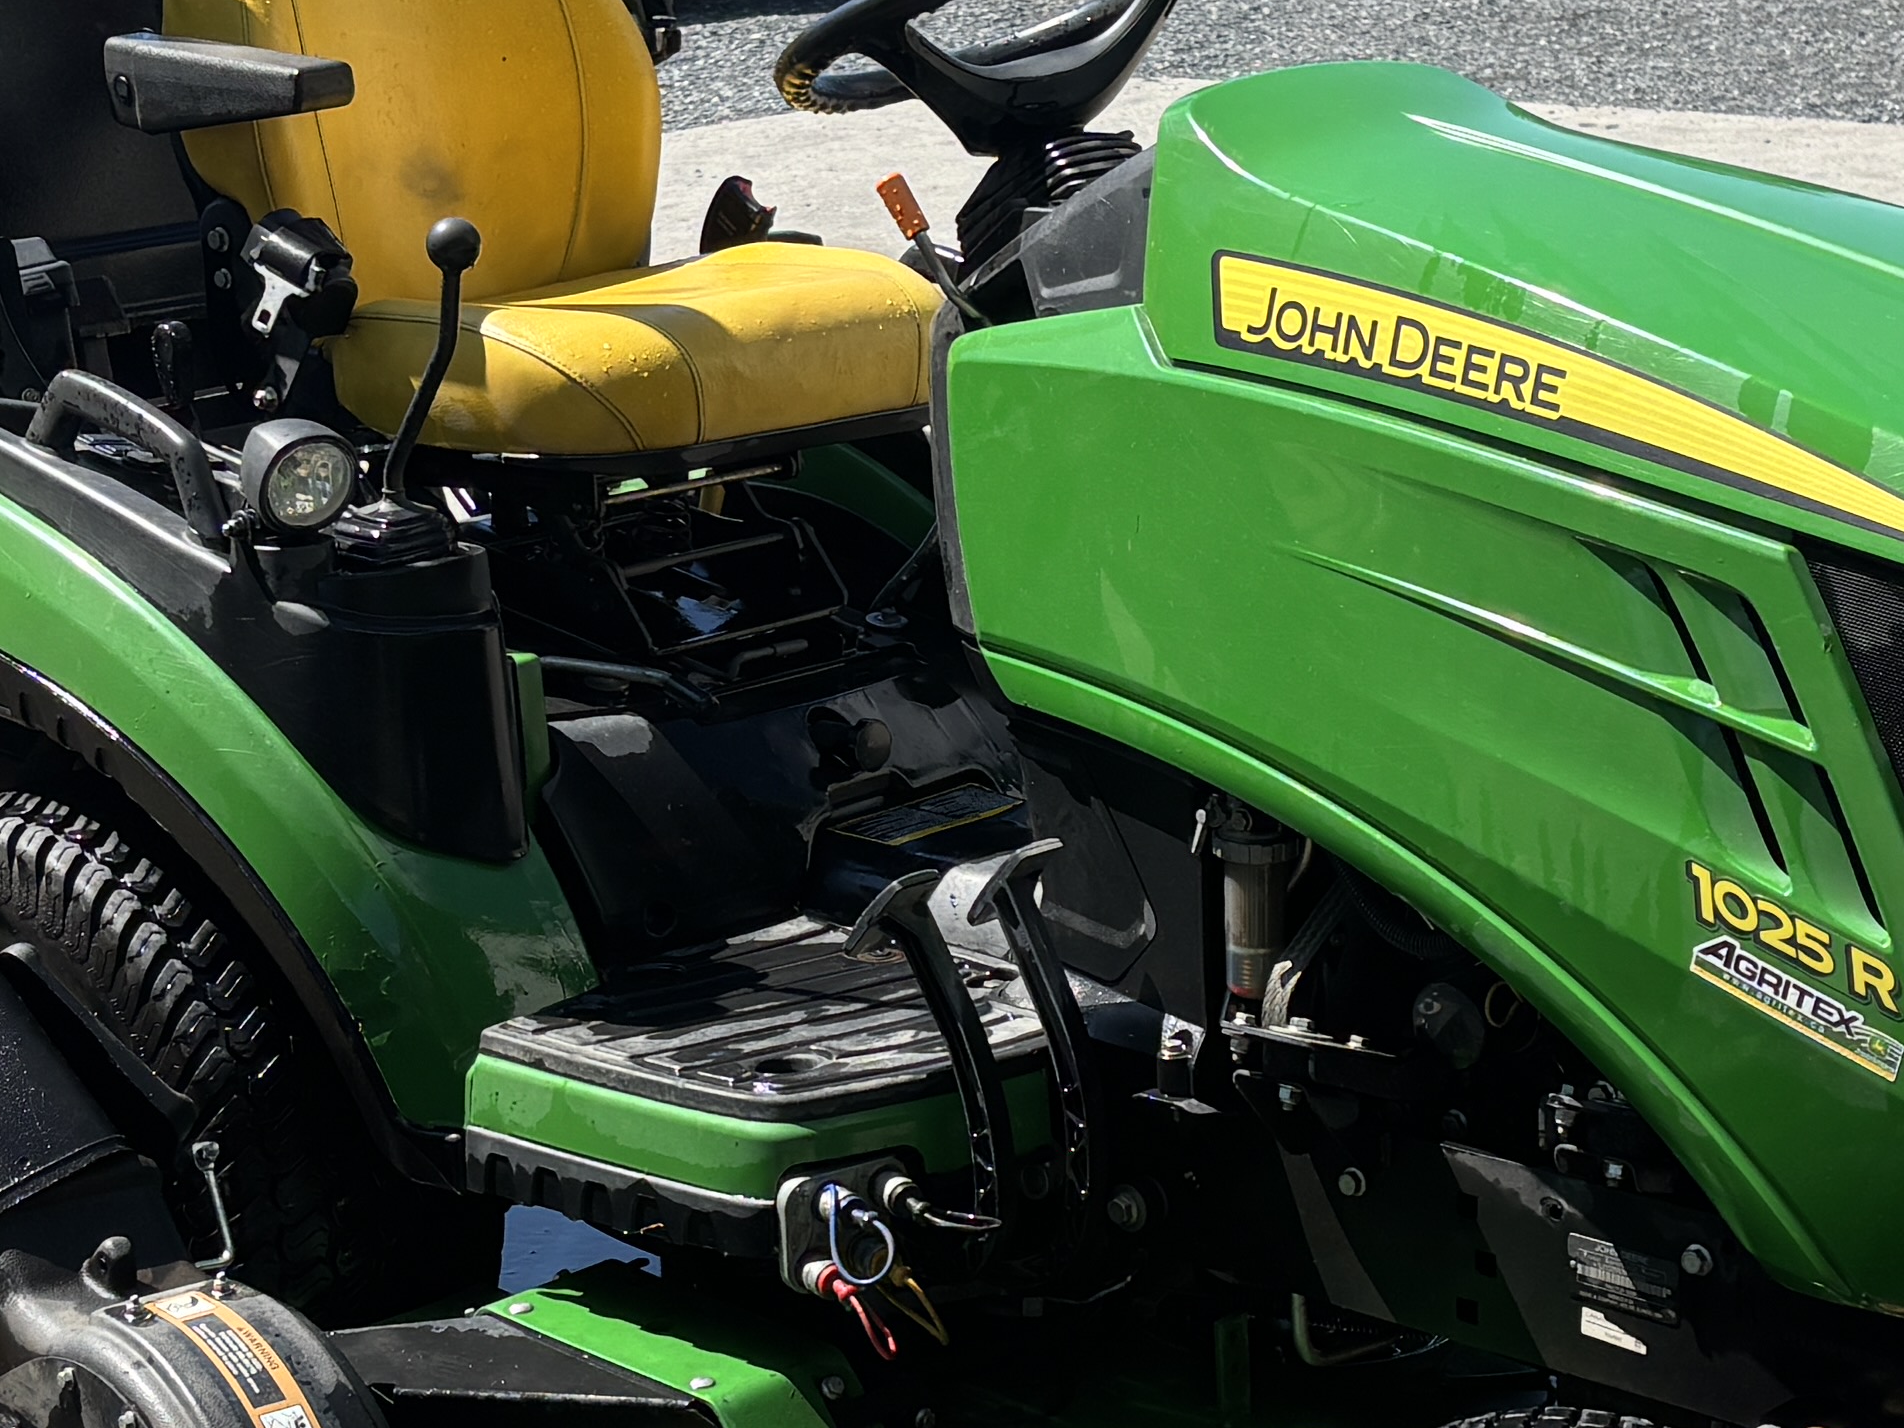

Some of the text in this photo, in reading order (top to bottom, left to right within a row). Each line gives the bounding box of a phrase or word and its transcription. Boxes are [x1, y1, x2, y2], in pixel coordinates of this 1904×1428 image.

[1245, 286, 1568, 414] JOHN DEERE
[1689, 861, 1900, 1014] 1025 R
[1698, 939, 1861, 1038] AGRITEX
[1722, 973, 1826, 1034] www.agritex.ca
[242, 1328, 280, 1371] WARNING
